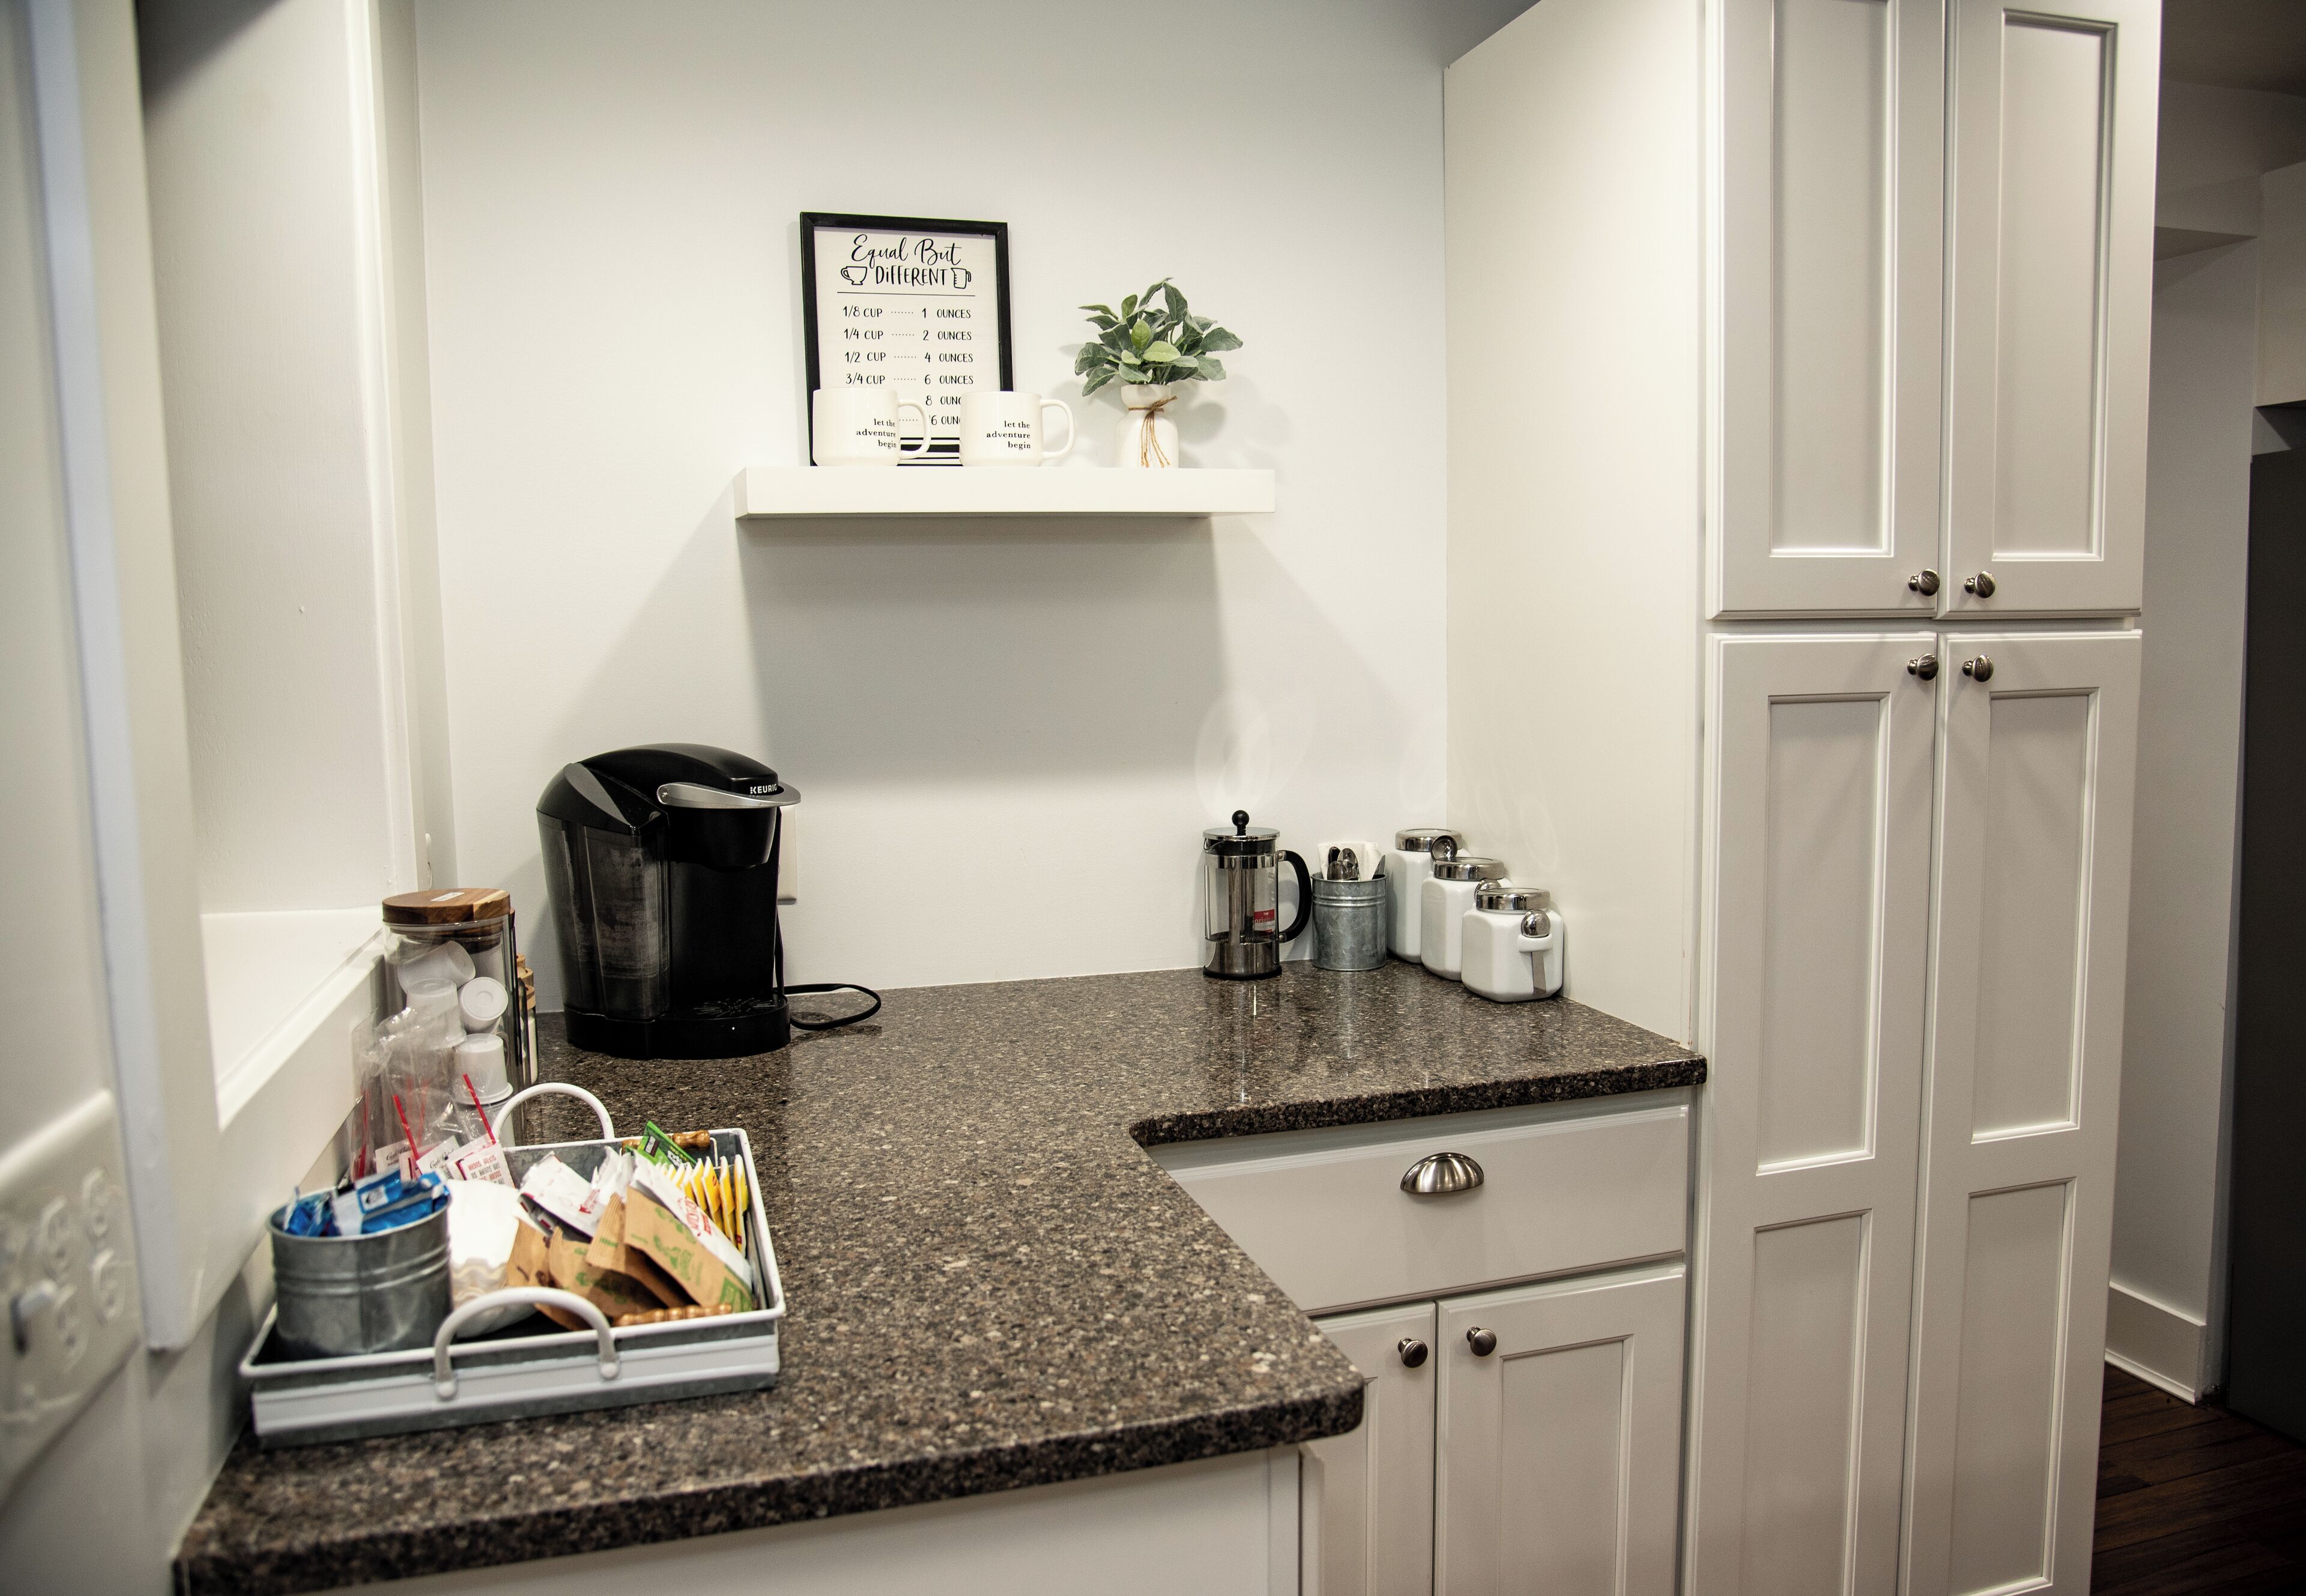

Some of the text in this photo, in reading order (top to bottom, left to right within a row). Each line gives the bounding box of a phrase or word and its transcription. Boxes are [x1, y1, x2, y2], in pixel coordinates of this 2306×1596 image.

[851, 234, 962, 268] Equal But
[843, 305, 971, 318] 1/8 CUP 1 OUNCES
[844, 327, 972, 340] 1/4 CUP 2 OUNCES
[844, 351, 973, 364] 1/2 CUP 4 OUNCES
[846, 372, 973, 385] 3/4 CUP 6 OUNCES
[925, 395, 933, 406] 8
[941, 416, 961, 425] OUN
[856, 428, 897, 437] adventure
[986, 431, 1030, 439] adventure
[878, 440, 897, 449] begin
[1008, 441, 1031, 450] begin
[749, 783, 778, 794] KEURIG
